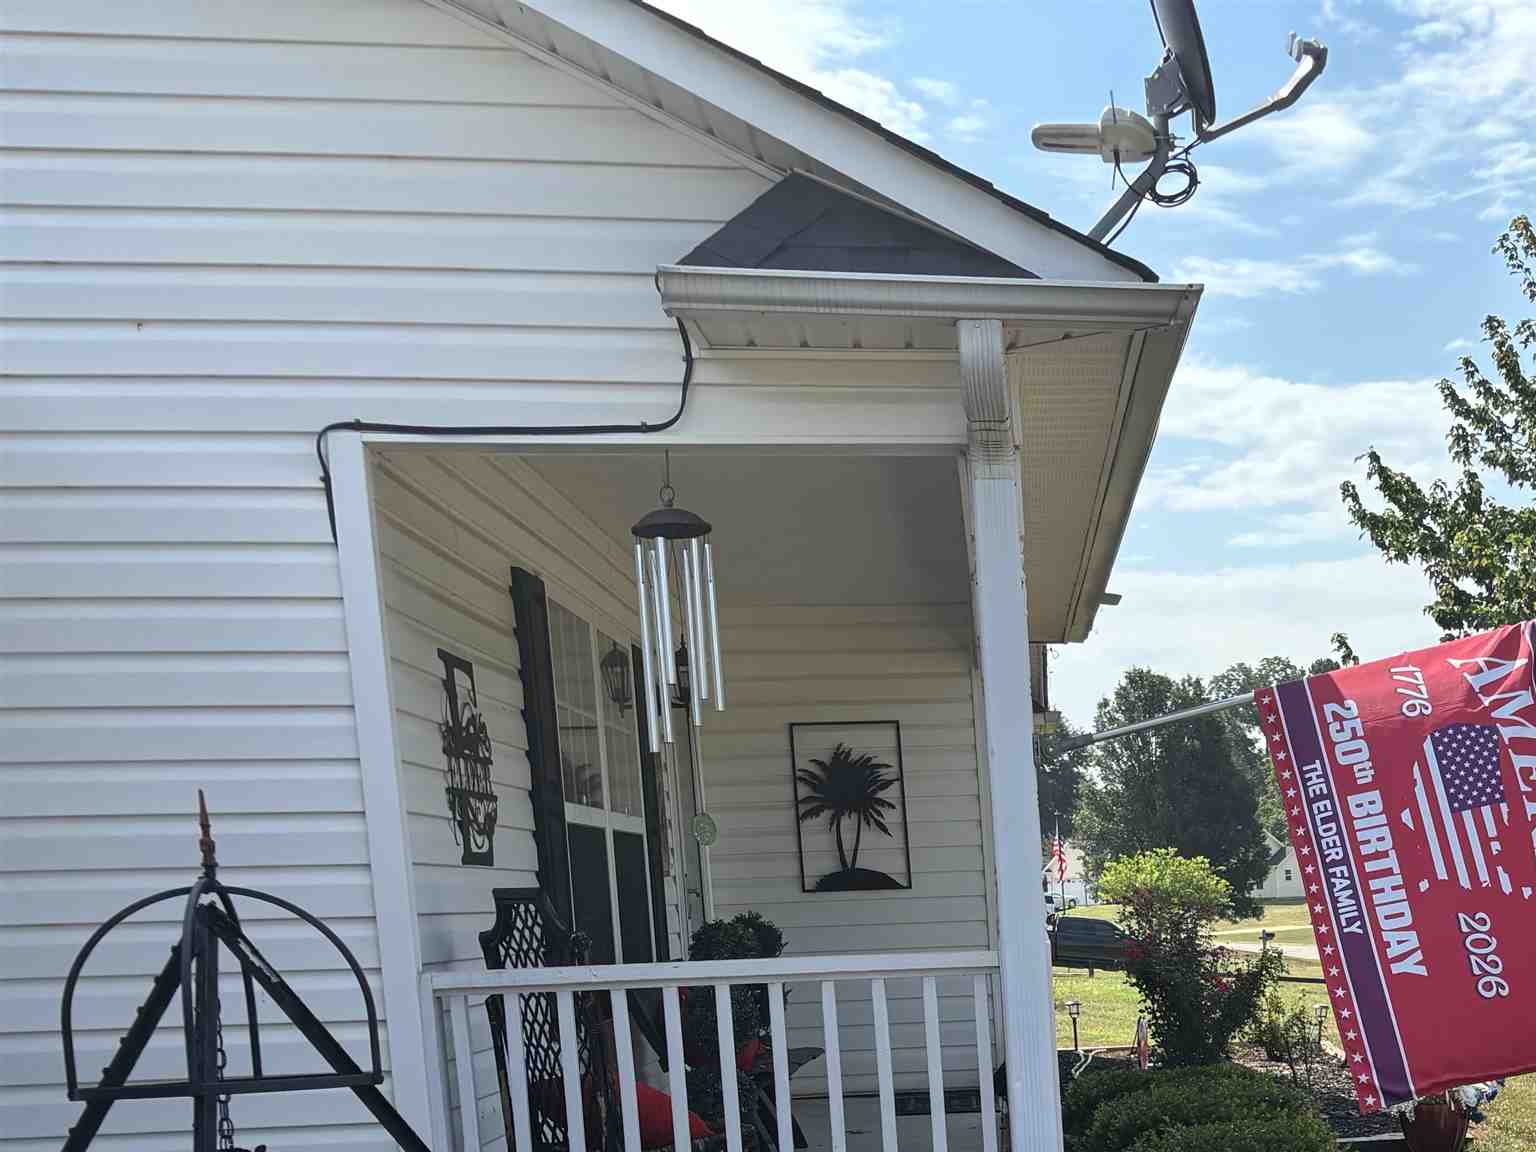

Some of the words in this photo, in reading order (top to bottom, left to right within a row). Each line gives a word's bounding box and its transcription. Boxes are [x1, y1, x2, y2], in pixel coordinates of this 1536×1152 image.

[1388, 664, 1433, 719] 1776
[1322, 699, 1377, 786] 250th
[1302, 759, 1328, 799] THE
[1312, 799, 1344, 864] ELDER
[1328, 864, 1364, 935] FAMILY
[1347, 789, 1429, 978] BIRTHDAY
[1456, 911, 1511, 1000] 2026
